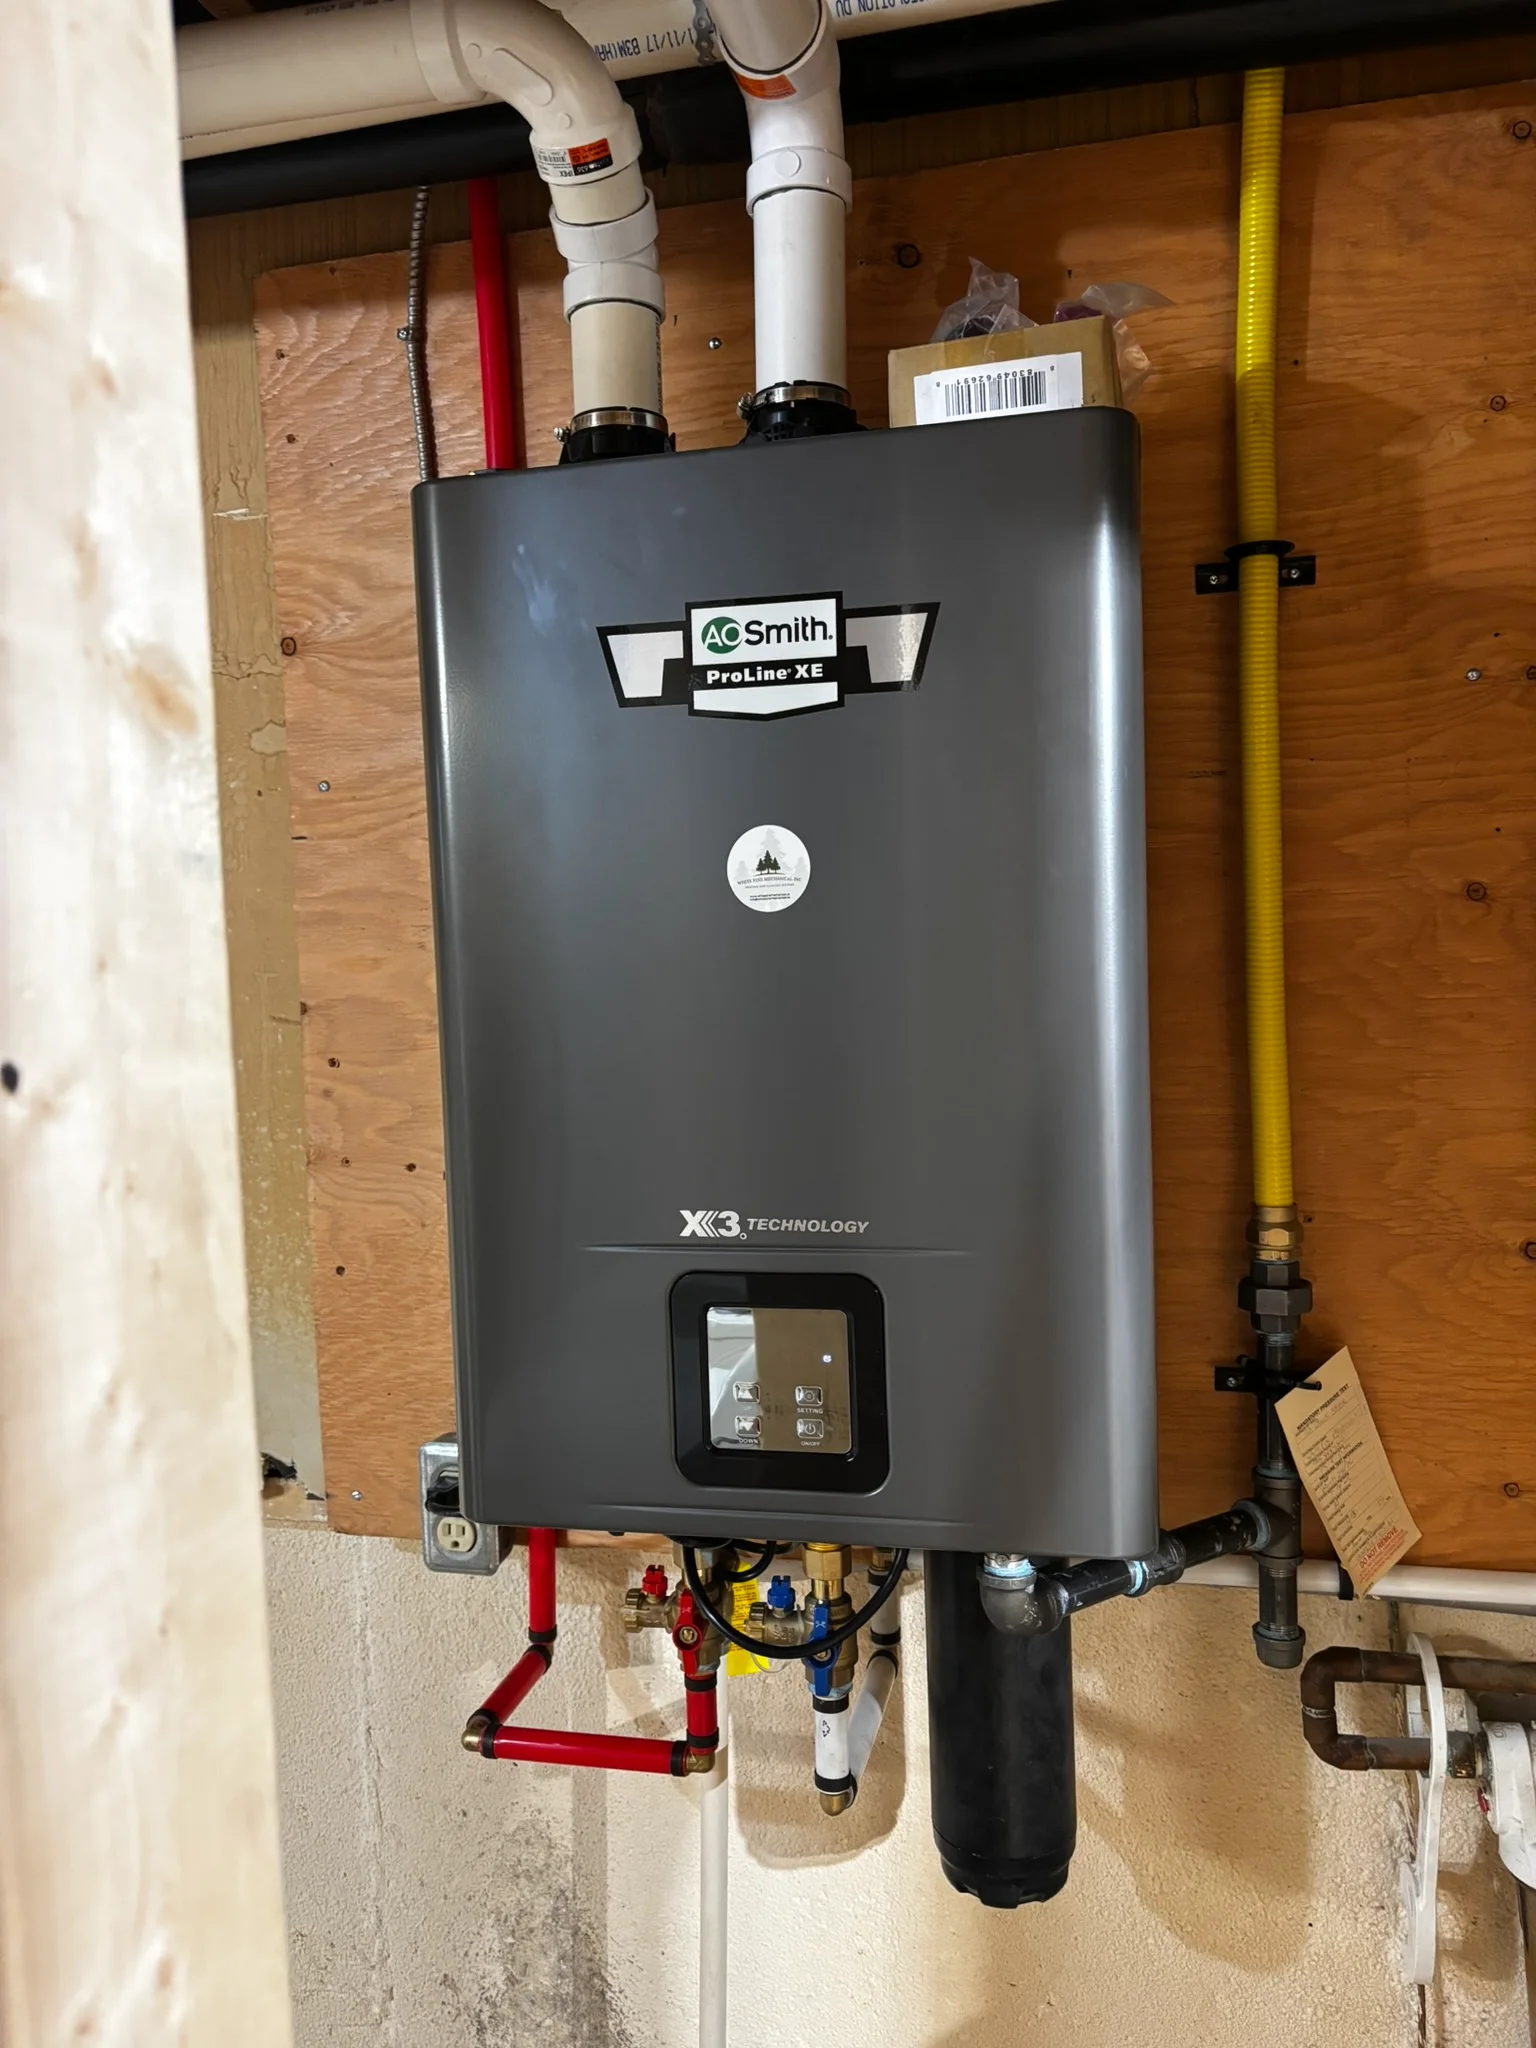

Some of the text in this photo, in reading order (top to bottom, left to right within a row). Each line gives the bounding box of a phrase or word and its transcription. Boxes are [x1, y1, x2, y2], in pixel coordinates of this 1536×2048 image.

[957, 374, 993, 386] 62691
[997, 368, 1033, 380] 83049
[794, 663, 823, 679] XE
[747, 1218, 869, 1234] TECHNOLOGY
[1339, 1383, 1349, 1394] TEST
[1360, 1527, 1398, 1568] DO NOT REMOVE
